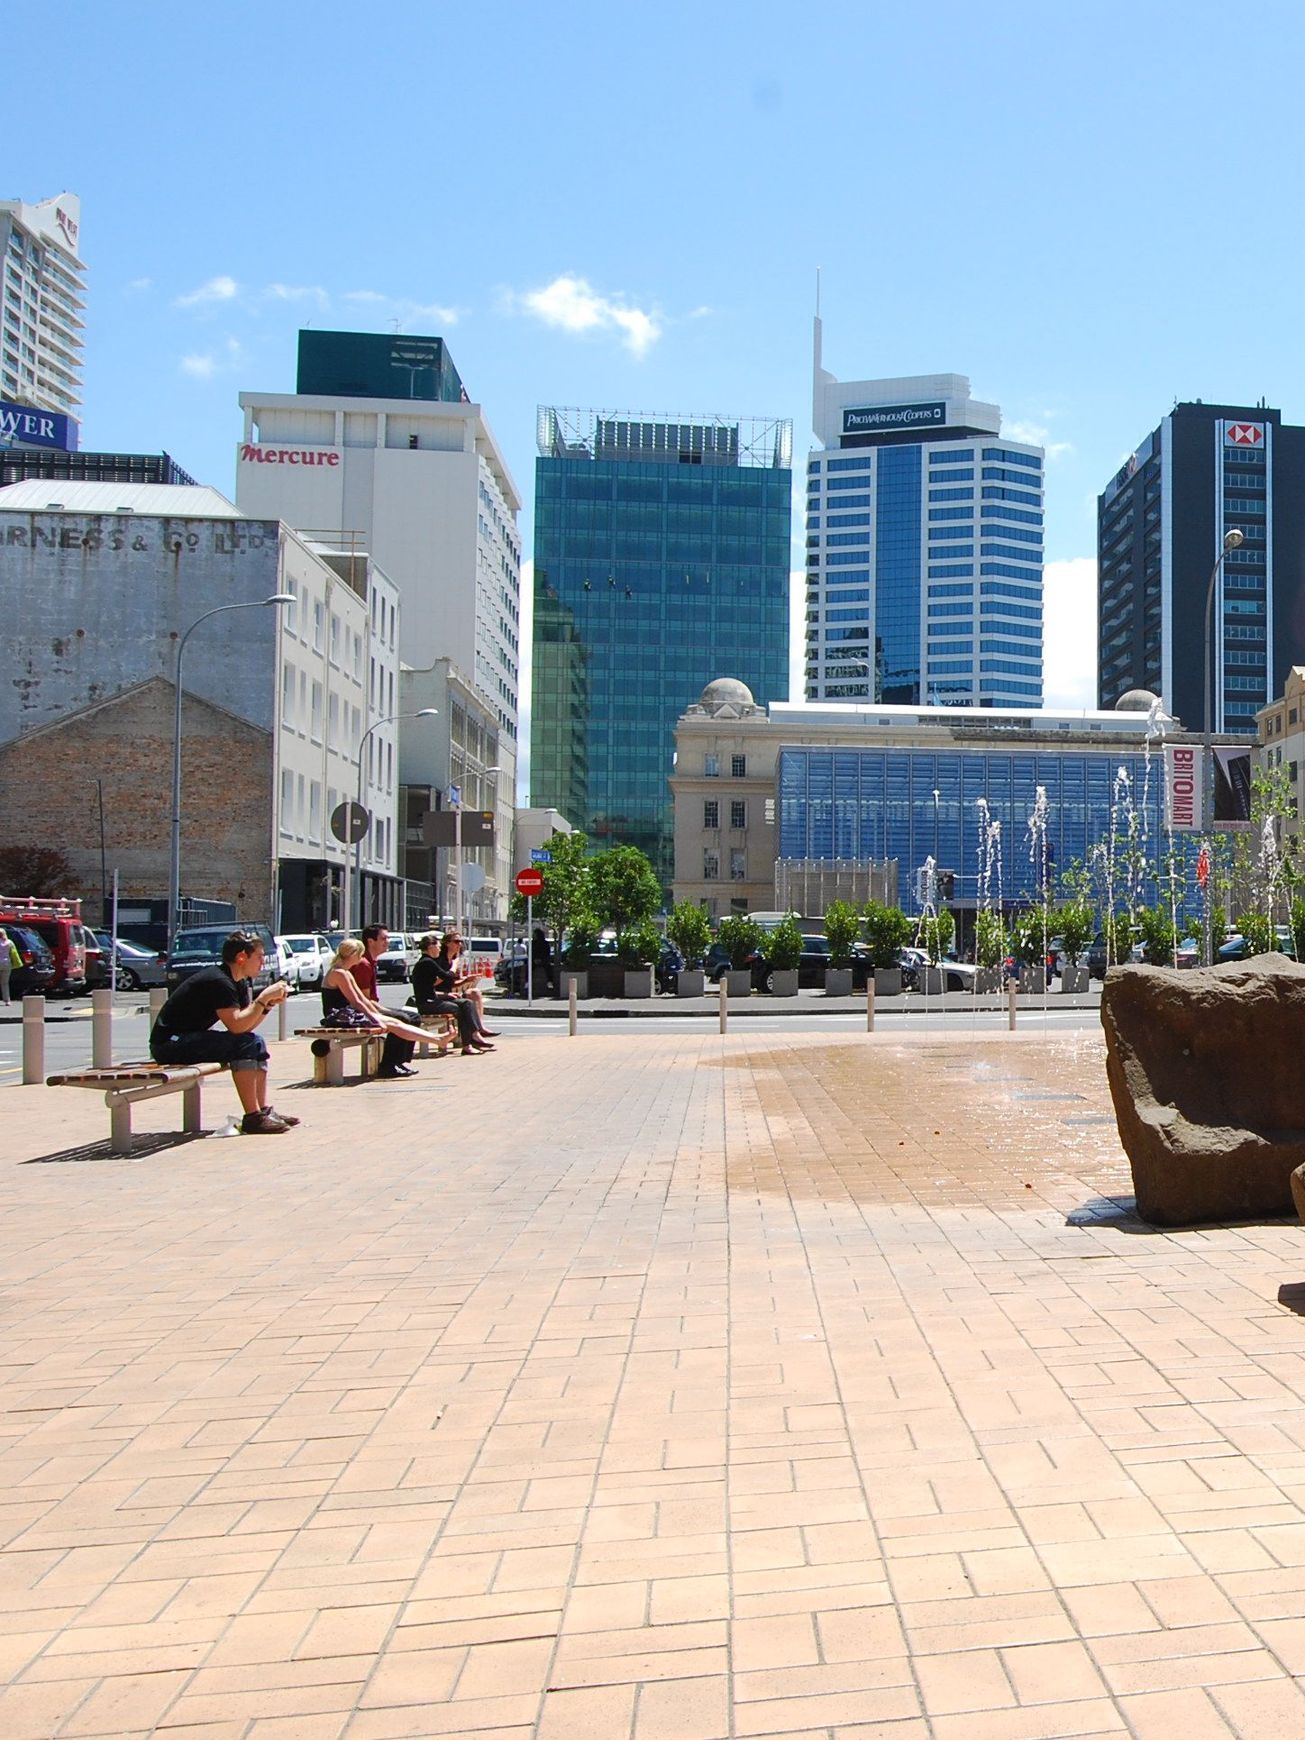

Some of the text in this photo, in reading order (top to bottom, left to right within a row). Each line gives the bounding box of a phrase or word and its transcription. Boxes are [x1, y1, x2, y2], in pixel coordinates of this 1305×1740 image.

[240, 443, 340, 466] Mercure
[0, 525, 125, 551] RNESS
[1172, 749, 1194, 827] BRITOMART
